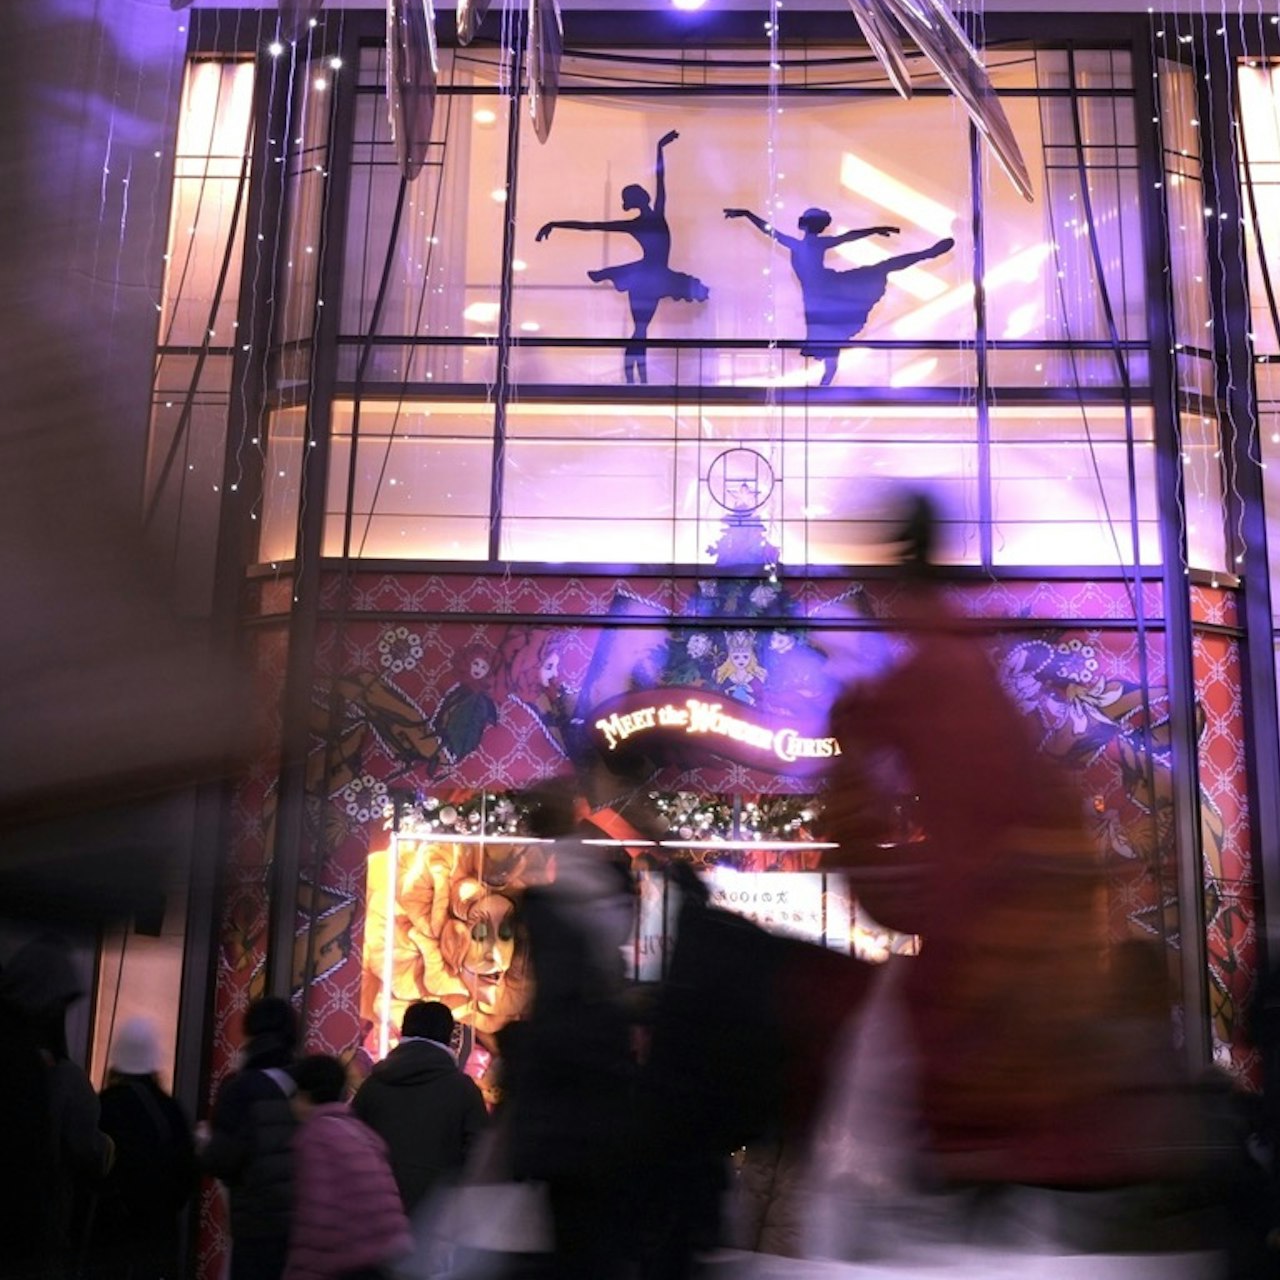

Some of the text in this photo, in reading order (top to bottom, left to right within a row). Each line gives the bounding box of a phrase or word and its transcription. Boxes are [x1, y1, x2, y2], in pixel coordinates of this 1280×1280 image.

[596, 707, 656, 750] MEET
[658, 705, 689, 725] the
[773, 728, 842, 762] CHRIST
